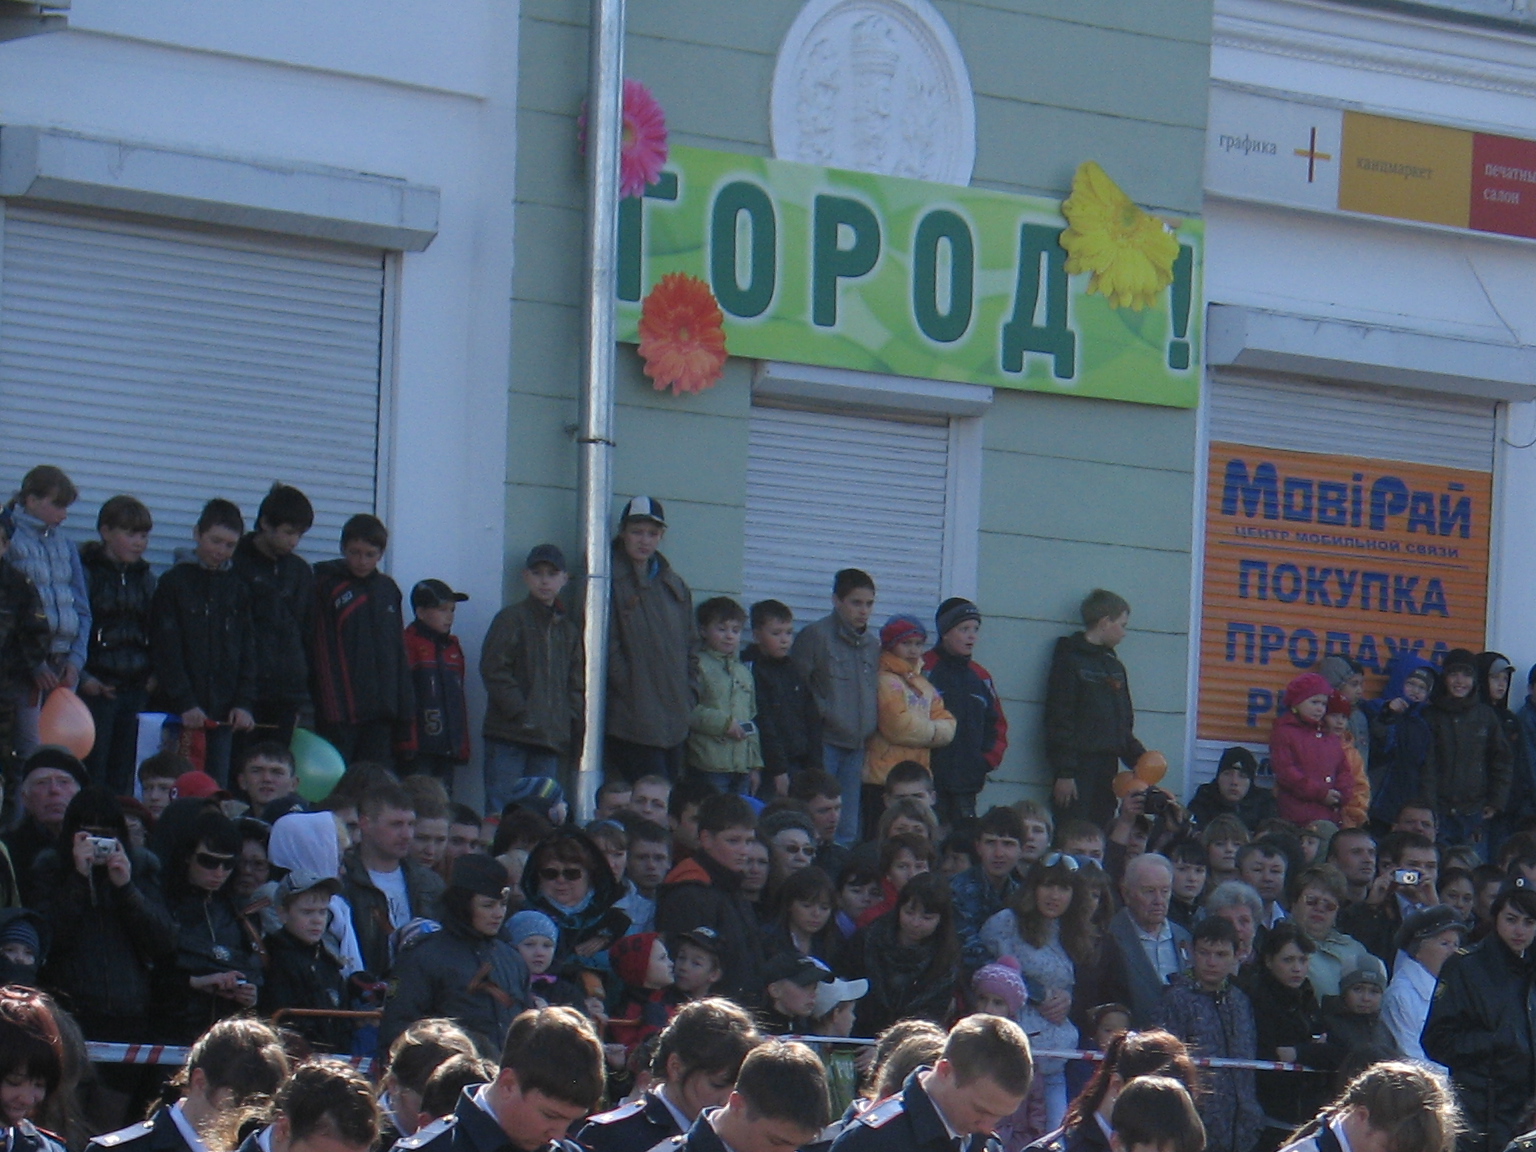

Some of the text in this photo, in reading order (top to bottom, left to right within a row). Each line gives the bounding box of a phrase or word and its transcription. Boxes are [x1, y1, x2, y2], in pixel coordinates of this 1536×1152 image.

[1218, 133, 1278, 156] графика
[1483, 186, 1521, 206] салон
[1234, 525, 1459, 558] ЦЕНТР МОБИЛЬНОЙ СВЯЗИ
[1238, 558, 1450, 618] ПОКУПКА
[424, 708, 442, 735] 5
